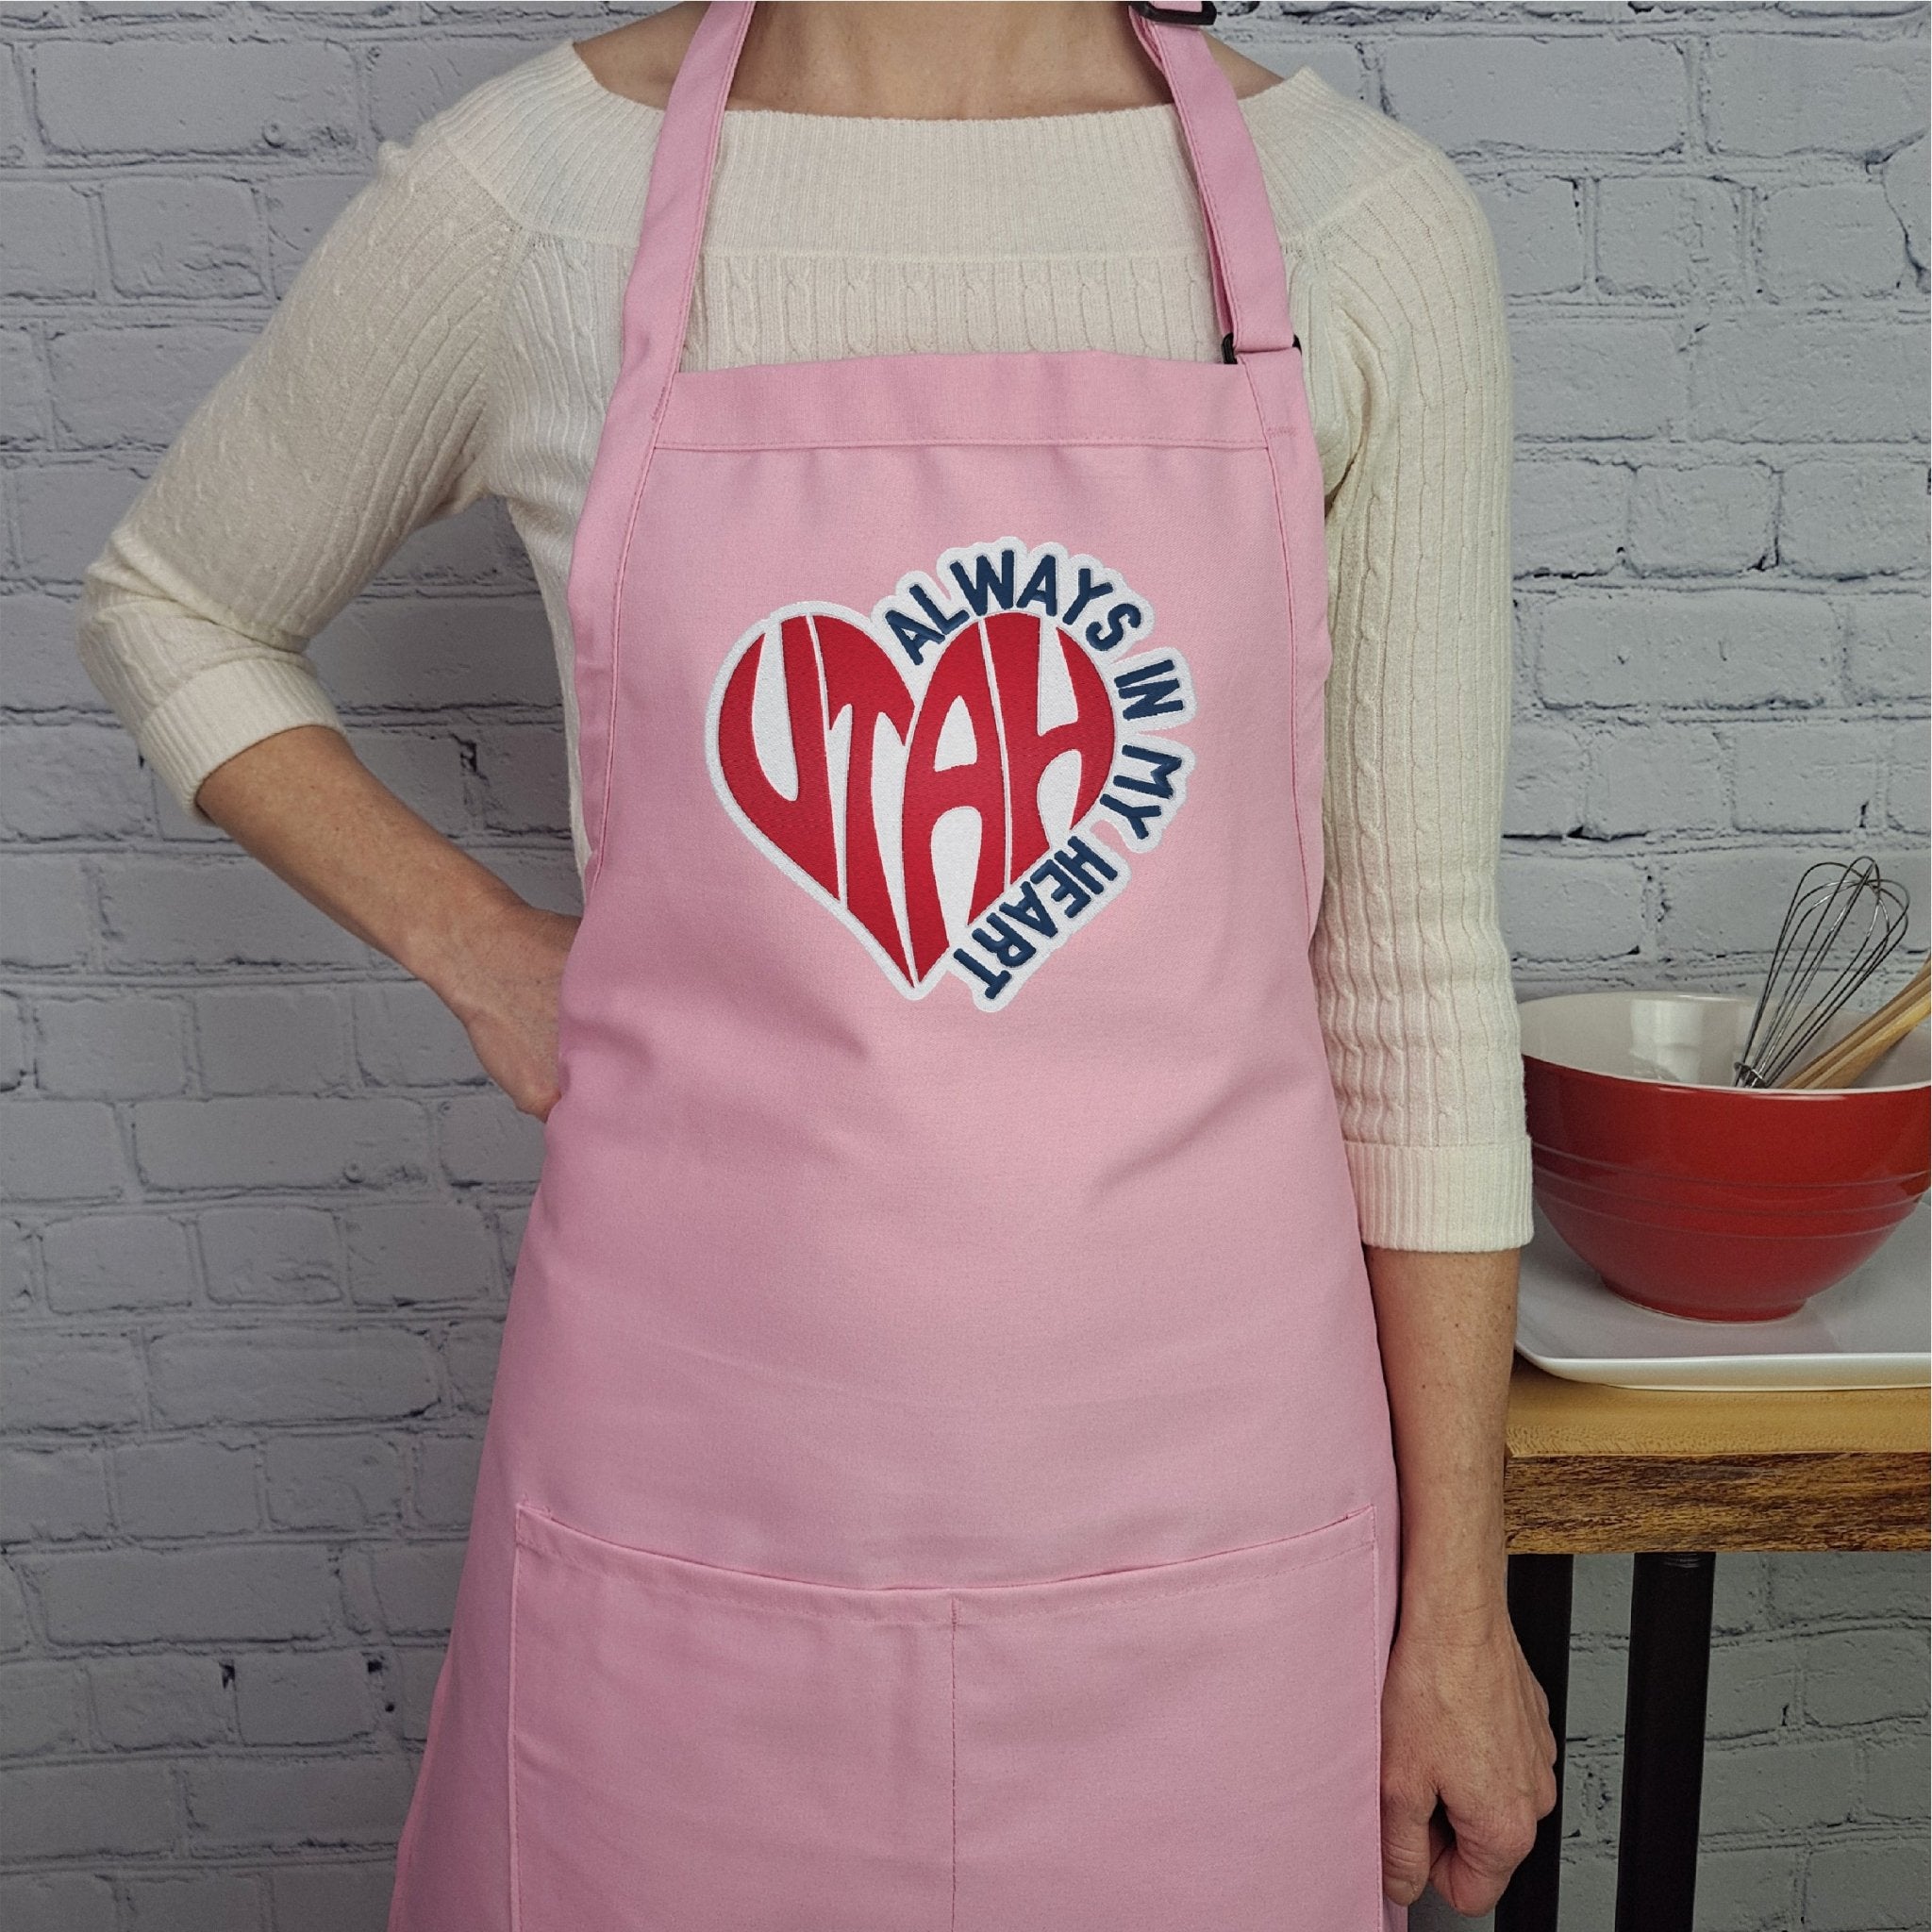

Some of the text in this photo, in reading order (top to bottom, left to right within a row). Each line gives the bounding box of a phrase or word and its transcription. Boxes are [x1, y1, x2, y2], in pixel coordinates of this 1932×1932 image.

[718, 612, 1116, 989] UTAH
[885, 549, 1185, 1000] ALWAYS IN MY HEART
